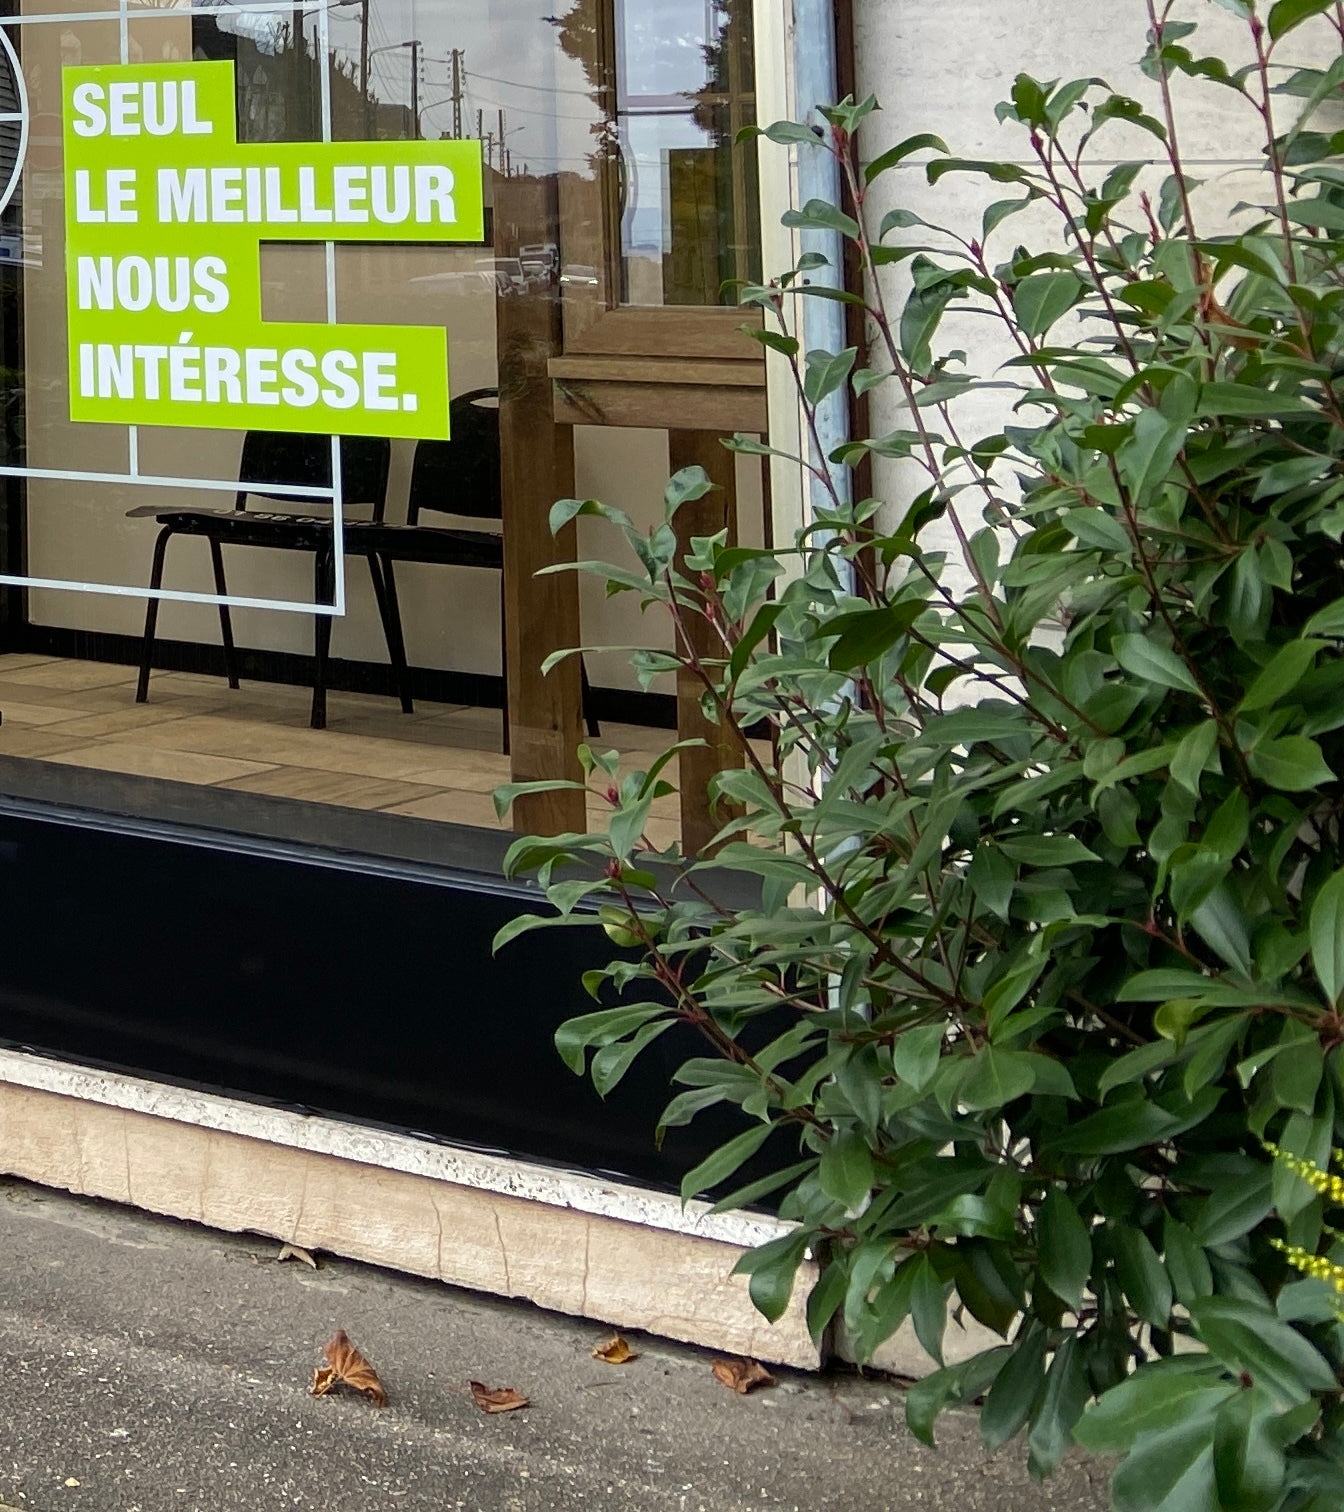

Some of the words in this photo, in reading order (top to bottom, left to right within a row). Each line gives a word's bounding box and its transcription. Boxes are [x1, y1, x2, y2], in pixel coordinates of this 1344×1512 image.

[73, 81, 212, 137] SEUL
[75, 169, 139, 223] LE
[157, 165, 458, 224] MEILLEUR
[77, 256, 230, 313] NOUS
[79, 331, 418, 411] INTÉRESSE.
